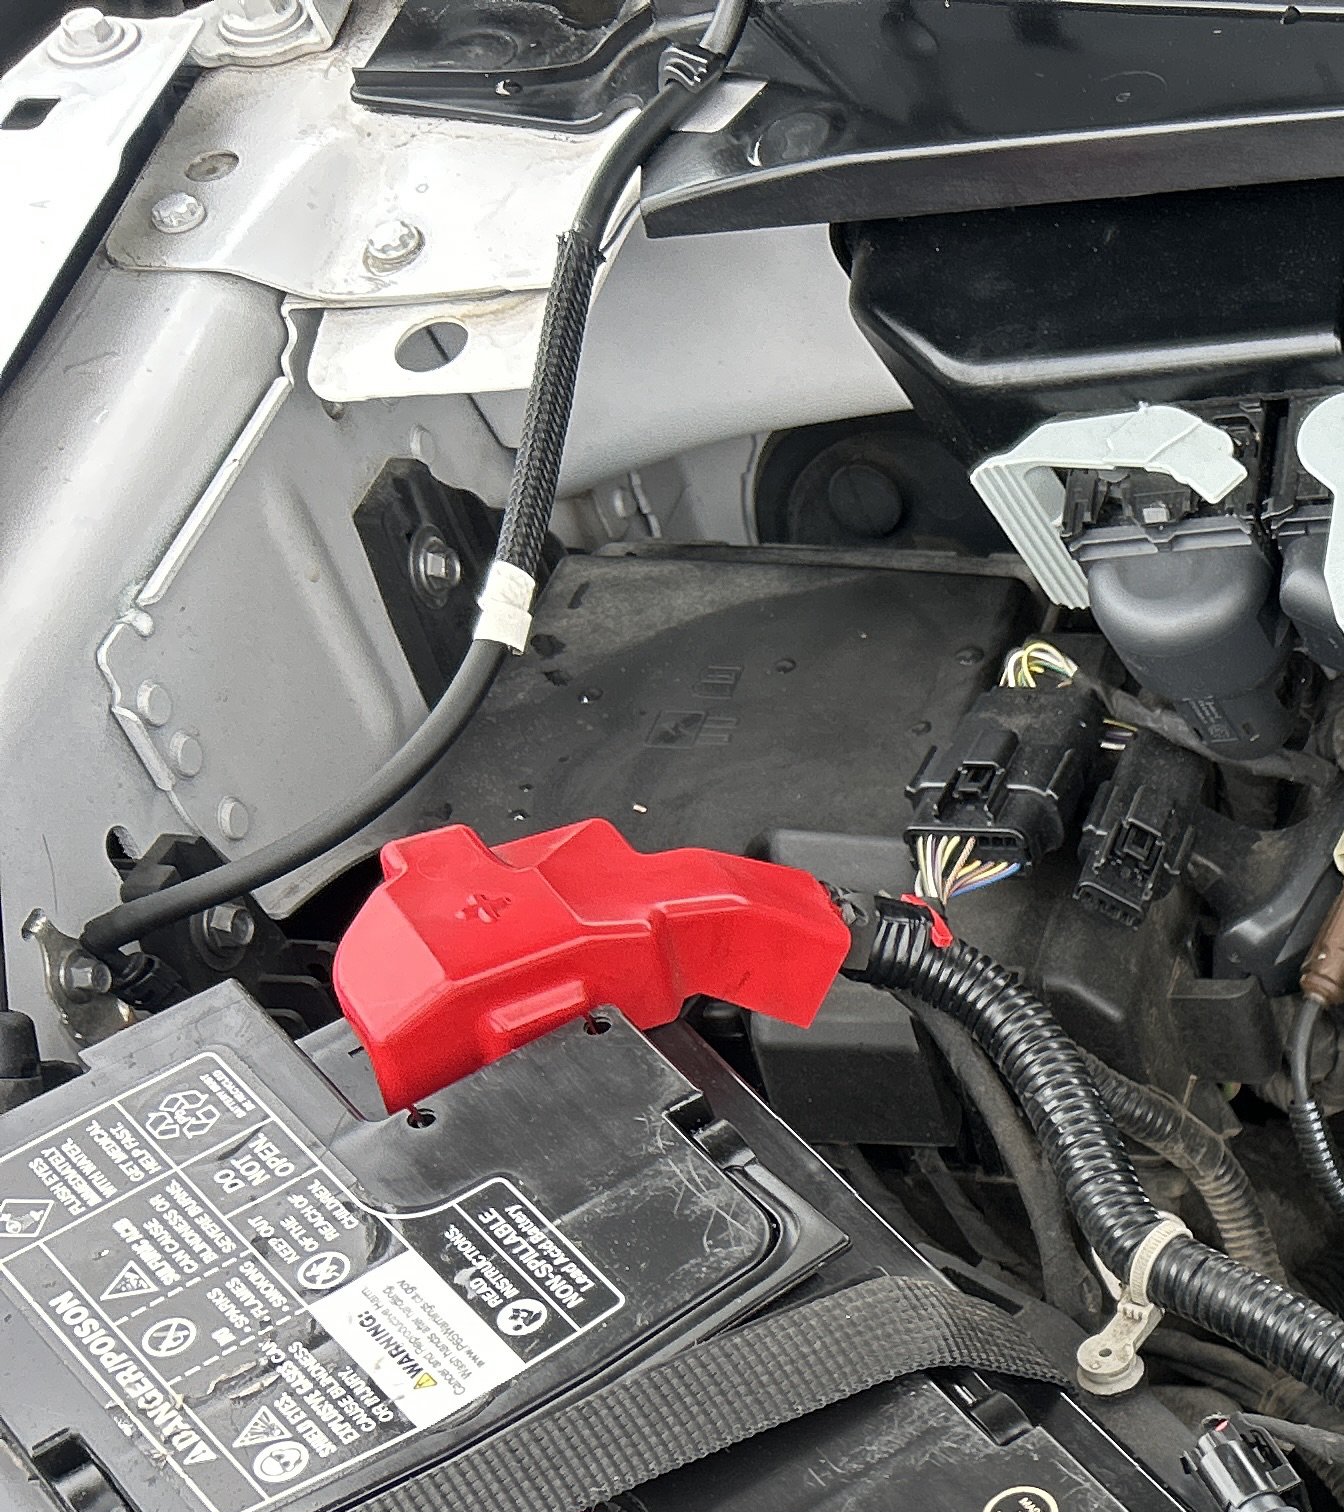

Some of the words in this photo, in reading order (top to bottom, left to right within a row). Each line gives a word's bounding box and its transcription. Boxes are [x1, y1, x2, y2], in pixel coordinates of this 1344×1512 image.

[212, 1068, 248, 1103] RECYCLED
[83, 1119, 130, 1164] MEDICAL
[108, 1121, 140, 1150] FAST.
[27, 1156, 59, 1185] EYES
[58, 1137, 97, 1174] WATER.
[119, 1160, 146, 1182] GET
[130, 1145, 162, 1173] HELP
[229, 1150, 271, 1186] NOT
[246, 1131, 297, 1178] OPEN.
[40, 1143, 103, 1207] IMMEDIATELY
[86, 1169, 118, 1197] WITH
[211, 1167, 246, 1194] DO
[47, 1179, 86, 1216] FLUSH
[147, 1192, 173, 1212] OR
[163, 1179, 204, 1217] BURNS.
[286, 1190, 310, 1209] OF
[305, 1178, 359, 1229] CHILDREN.
[110, 1216, 142, 1243] ACID
[141, 1216, 181, 1253] CAUSE
[162, 1207, 219, 1264] BLINDNESS
[193, 1212, 237, 1253] SEVERE
[246, 1213, 277, 1238] OUT
[279, 1214, 309, 1242] THE
[300, 1204, 340, 1241] REACH
[502, 1201, 550, 1243] Battery
[170, 1249, 200, 1273] CAN
[266, 1233, 301, 1264] KEEP
[296, 1234, 321, 1253] OF
[442, 1222, 521, 1299] INSTRUCTIONS.
[477, 1206, 585, 1308] NON-SPILLABLE
[536, 1238, 570, 1266] Acid
[130, 1238, 181, 1286] SULFURIC
[559, 1262, 595, 1292] Lead
[468, 1276, 504, 1307] READ
[210, 1326, 236, 1346] NO
[378, 1307, 429, 1355] Reproductive
[424, 1332, 453, 1357] hands
[47, 1289, 199, 1450] DANGER/POISON
[276, 1358, 316, 1394] GASES
[286, 1339, 347, 1400] BLINDNESS
[420, 1351, 442, 1369] and
[445, 1354, 474, 1380] Wash
[335, 1365, 381, 1407] INJURY.
[434, 1366, 466, 1395] Cancer
[271, 1392, 308, 1425] EYES.
[303, 1389, 360, 1444] EXPLOSIVE
[336, 1395, 378, 1433] CAUSE
[370, 1403, 395, 1423] OR
[295, 1419, 339, 1457] SHIELD
